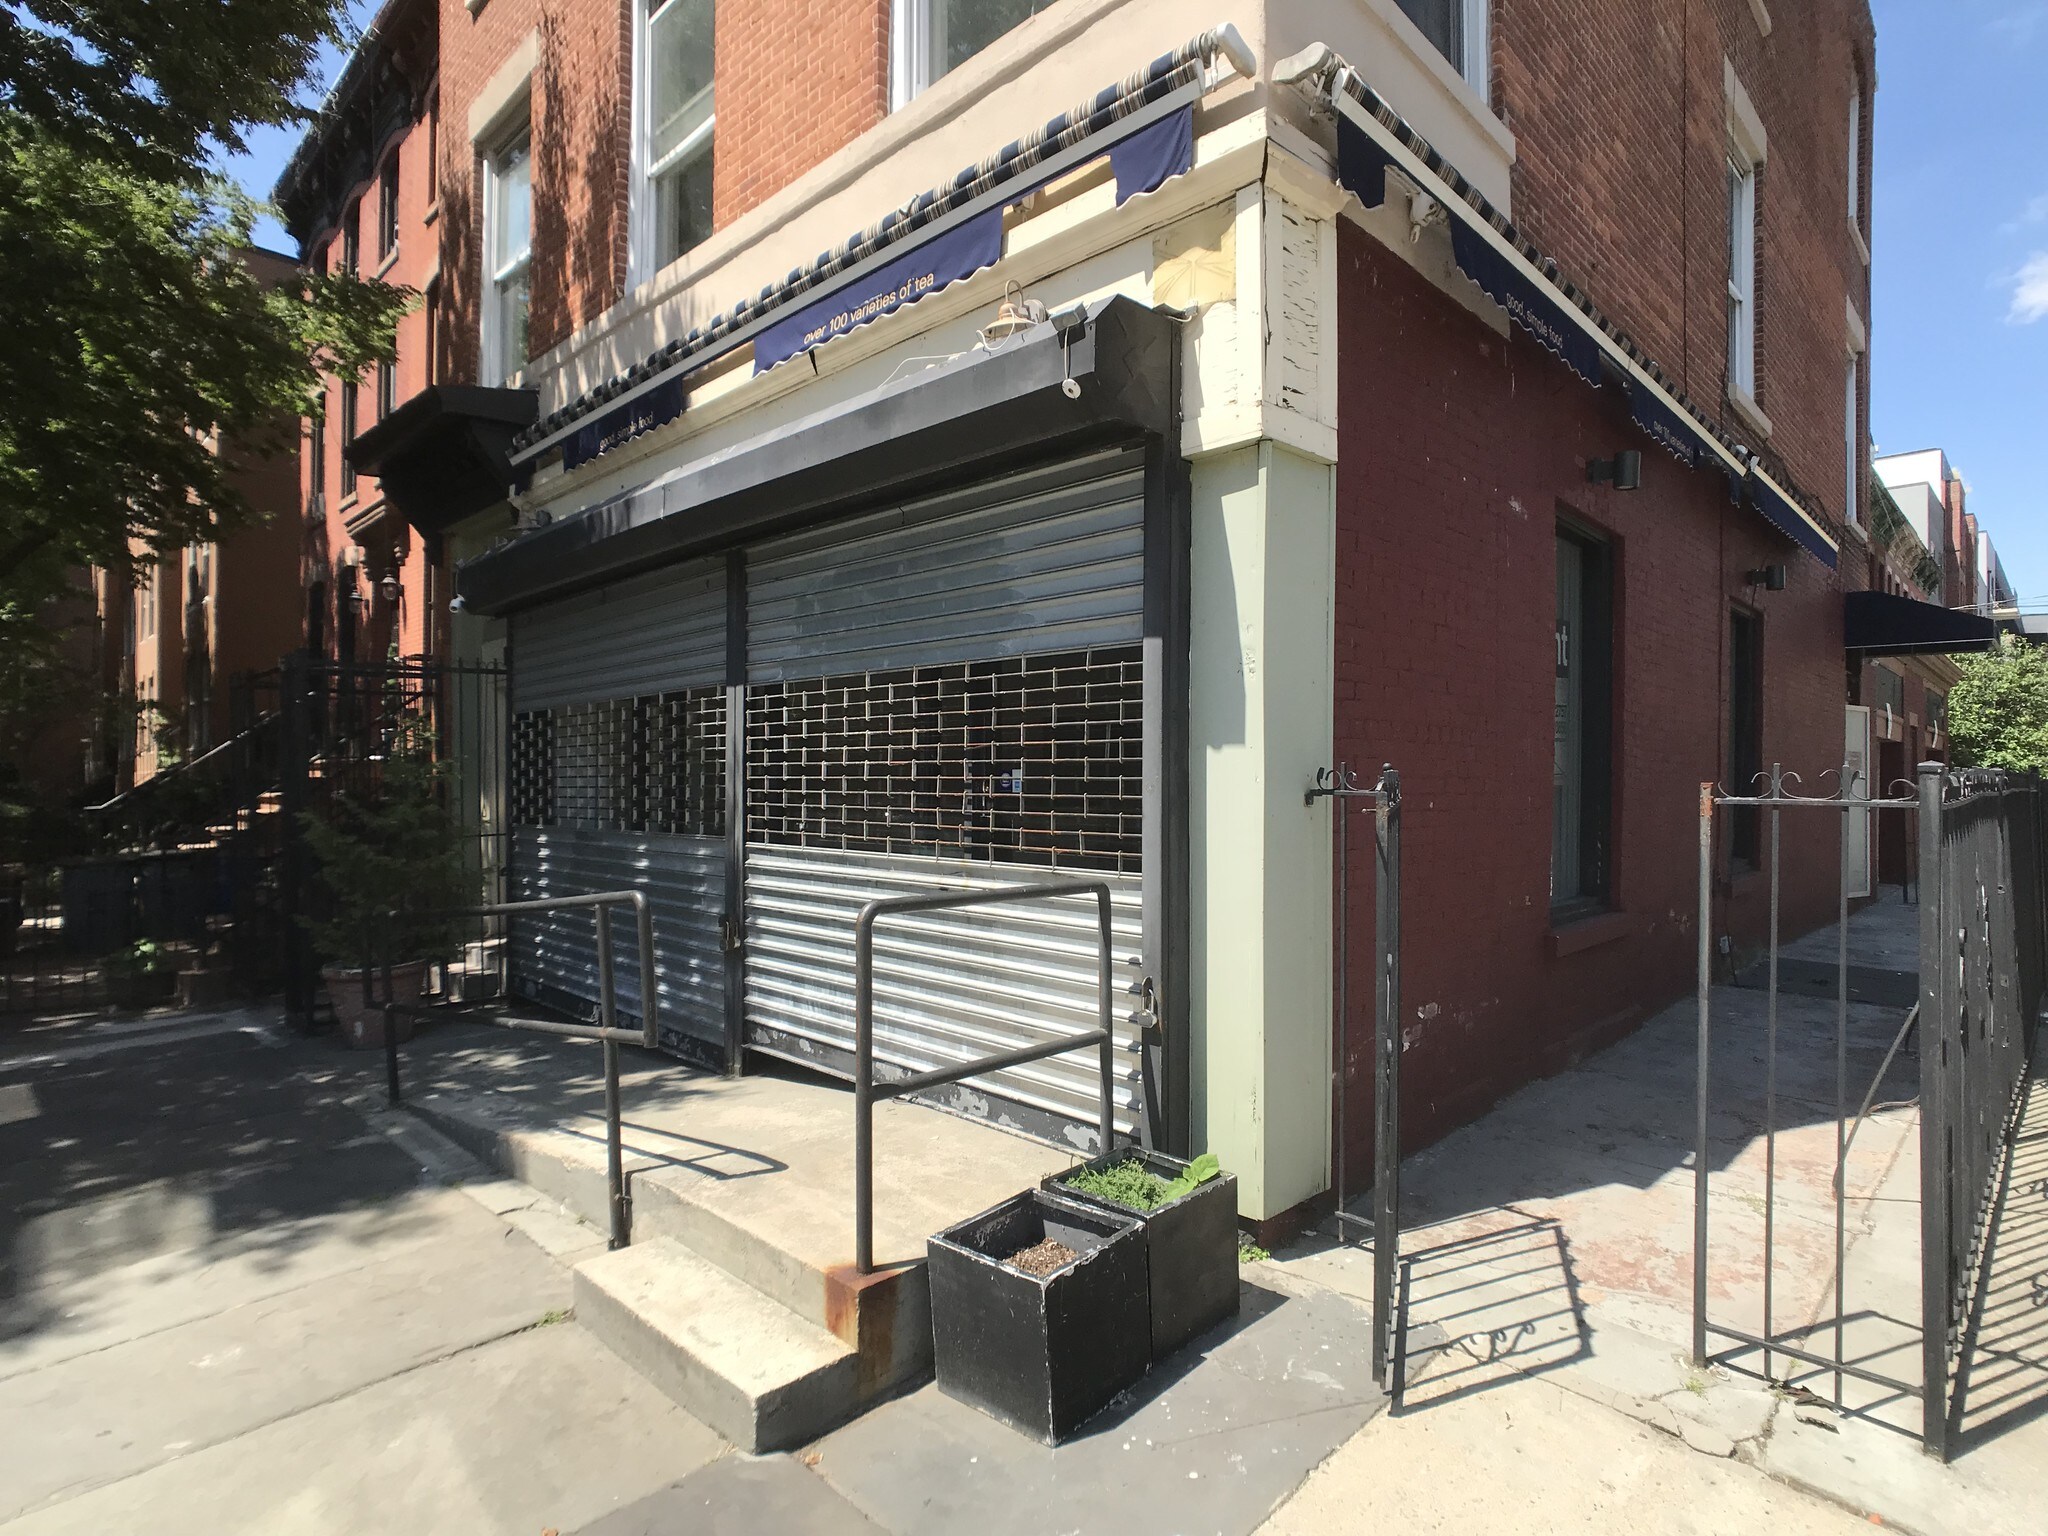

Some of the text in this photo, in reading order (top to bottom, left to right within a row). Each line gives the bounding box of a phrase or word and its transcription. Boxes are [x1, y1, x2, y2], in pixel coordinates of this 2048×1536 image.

[803, 272, 935, 345] over 100 varieties of tea
